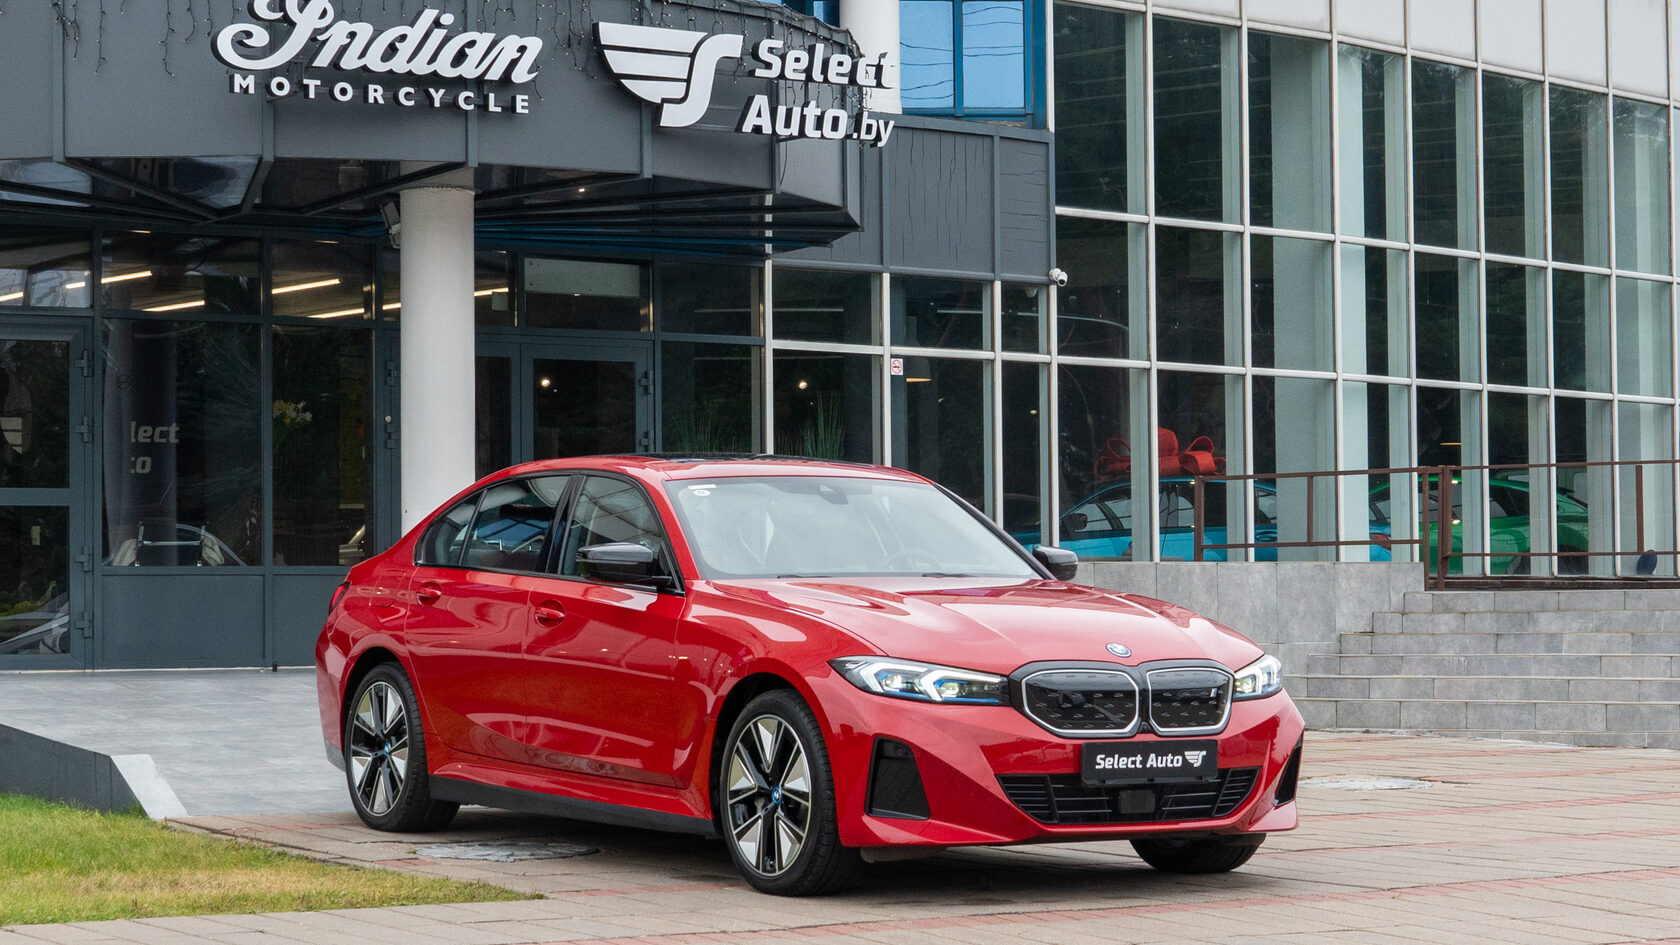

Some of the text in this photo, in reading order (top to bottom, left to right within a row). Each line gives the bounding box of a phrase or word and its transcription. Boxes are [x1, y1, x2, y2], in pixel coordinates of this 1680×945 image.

[215, 0, 544, 84] Indian
[754, 38, 897, 88] Select
[232, 73, 530, 115] MOTORCYCLE
[130, 421, 180, 443] lect
[1095, 753, 1183, 769] Select Auto
